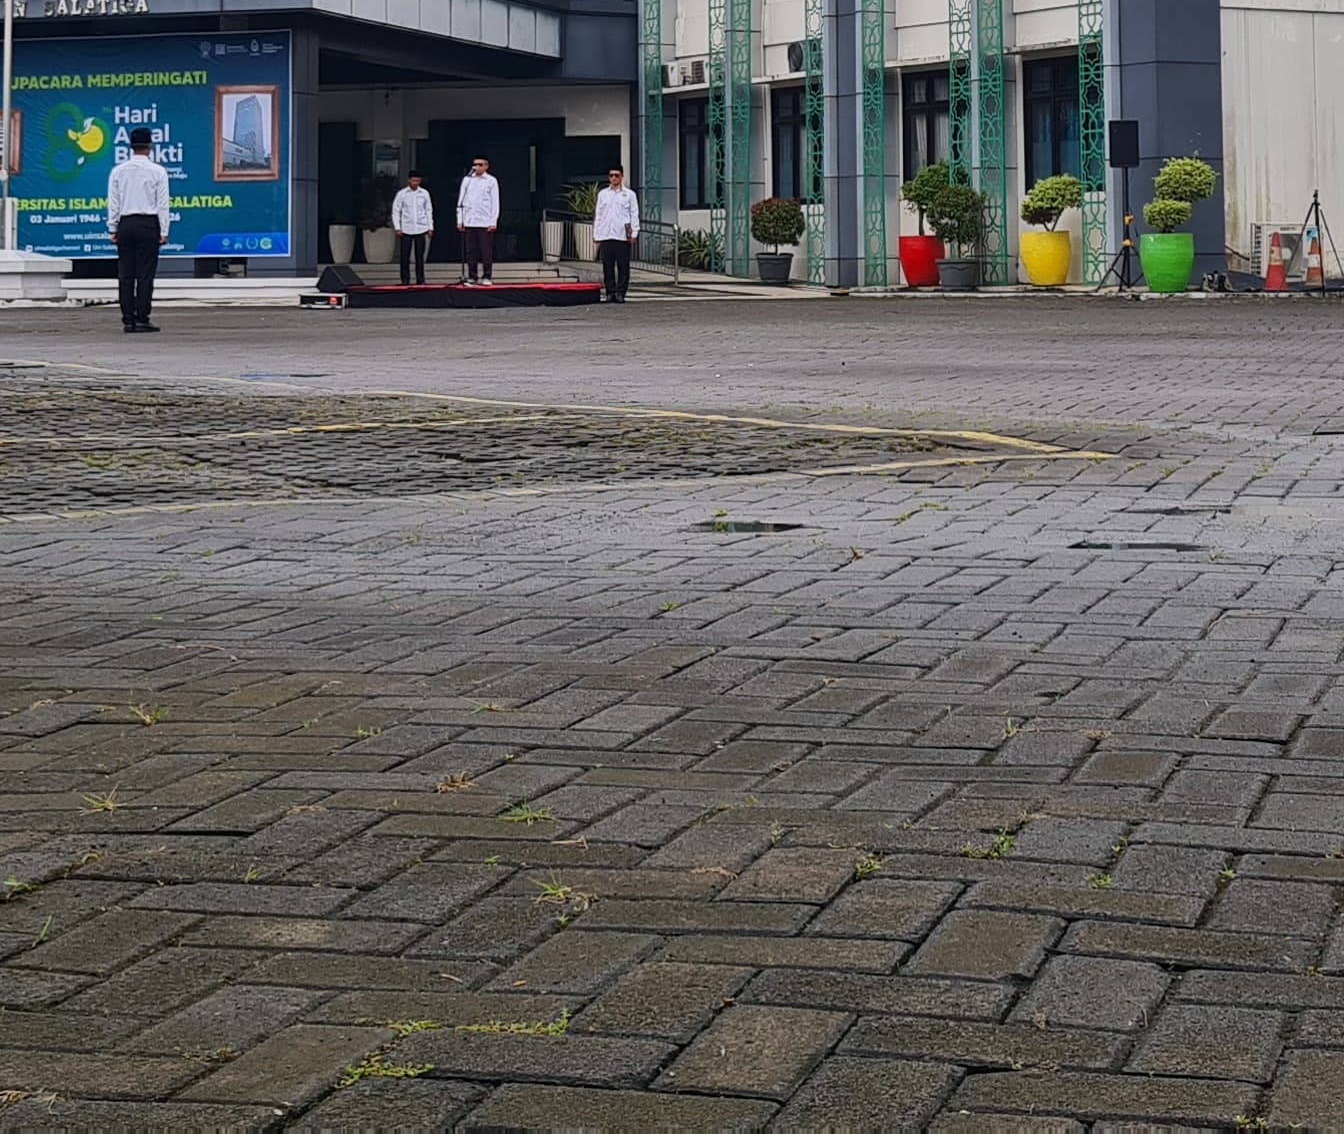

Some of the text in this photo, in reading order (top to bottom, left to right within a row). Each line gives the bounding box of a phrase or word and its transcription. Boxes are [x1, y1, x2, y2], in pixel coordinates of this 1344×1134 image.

[87, 71, 208, 88] MEMPERINGATI
[114, 104, 157, 124] Hari
[114, 124, 170, 144] Aal
